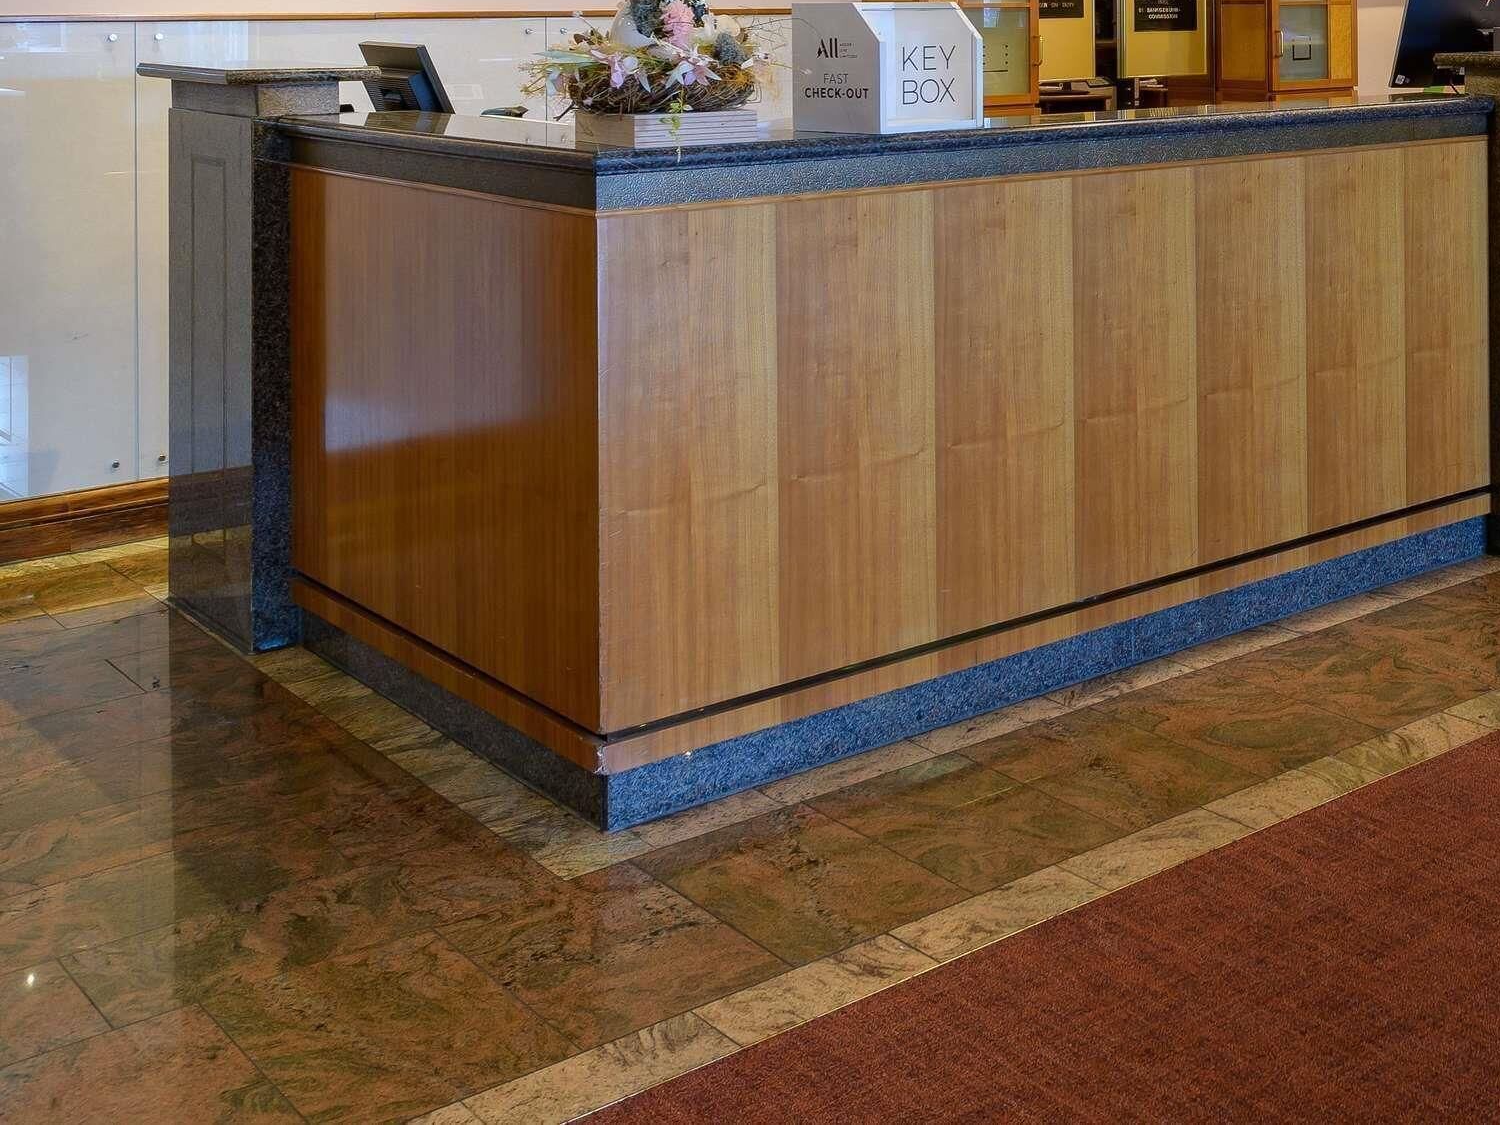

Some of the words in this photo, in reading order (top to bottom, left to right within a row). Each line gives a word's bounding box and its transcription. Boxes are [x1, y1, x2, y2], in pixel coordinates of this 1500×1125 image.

[816, 37, 839, 59] All
[902, 45, 956, 72] KEY
[823, 73, 849, 85] FAST
[804, 87, 869, 99] CHECK-OUT
[902, 77, 956, 105] BOX
